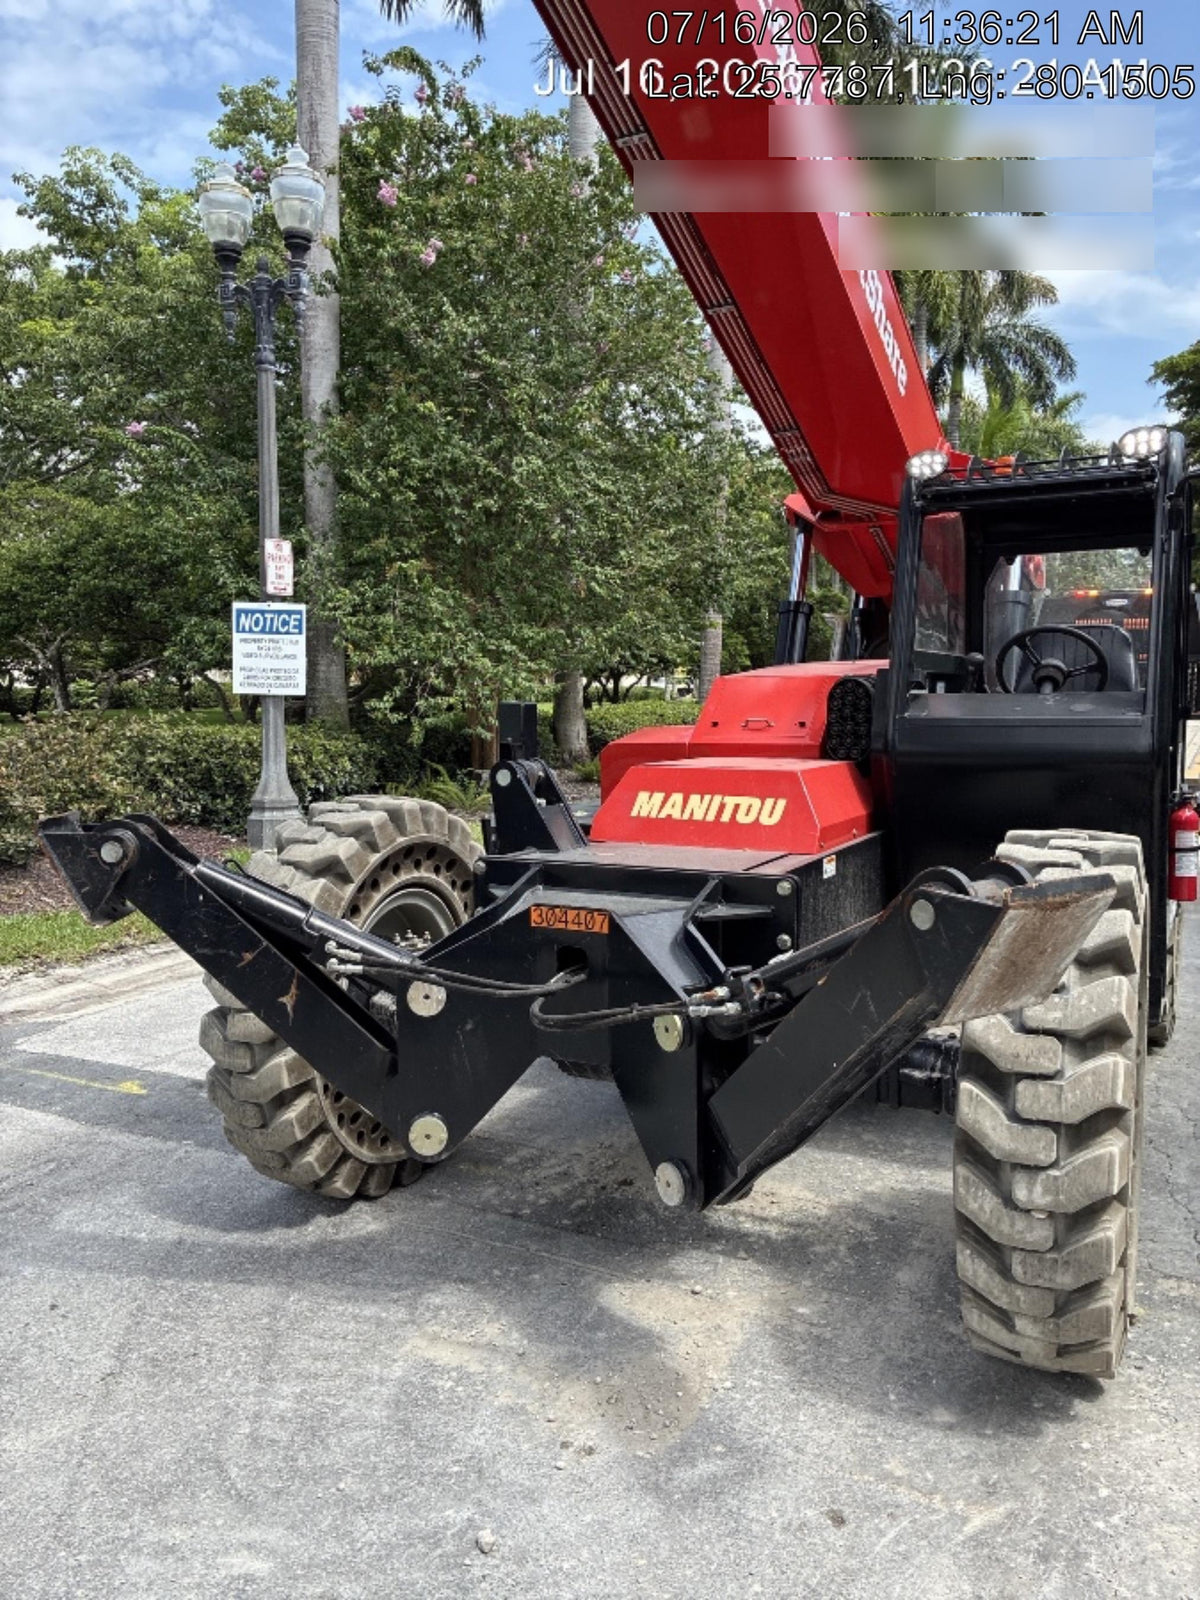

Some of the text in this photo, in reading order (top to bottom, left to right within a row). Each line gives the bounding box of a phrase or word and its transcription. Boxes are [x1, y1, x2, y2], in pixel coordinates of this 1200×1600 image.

[239, 612, 301, 633] NOTICE
[630, 790, 788, 826] MANITOU
[532, 906, 607, 931] 304407
